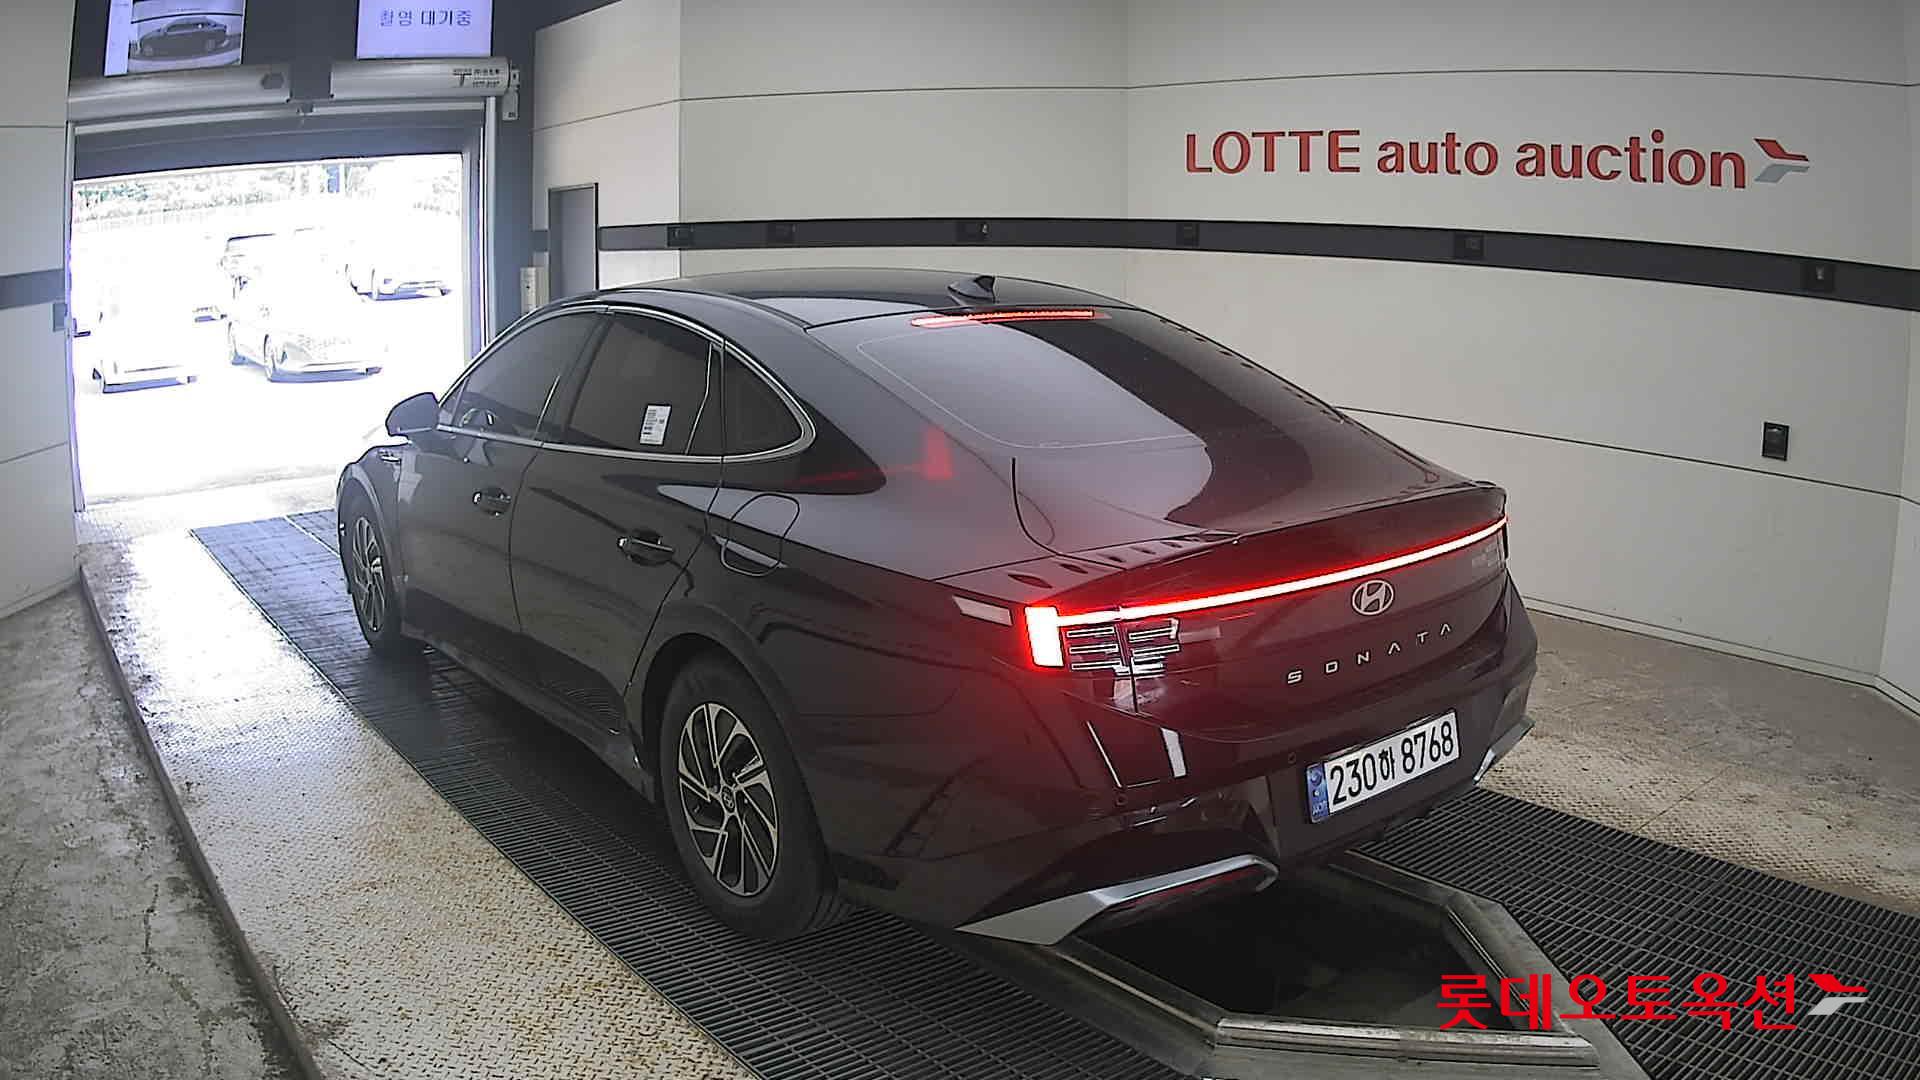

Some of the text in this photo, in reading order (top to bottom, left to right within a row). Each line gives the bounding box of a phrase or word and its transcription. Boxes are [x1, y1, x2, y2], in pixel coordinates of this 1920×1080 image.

[421, 9, 471, 26] 대기중
[1186, 129, 1747, 190] LOTTE auto auction
[1286, 622, 1452, 685] SONATA
[1329, 720, 1454, 806] 230하 8768
